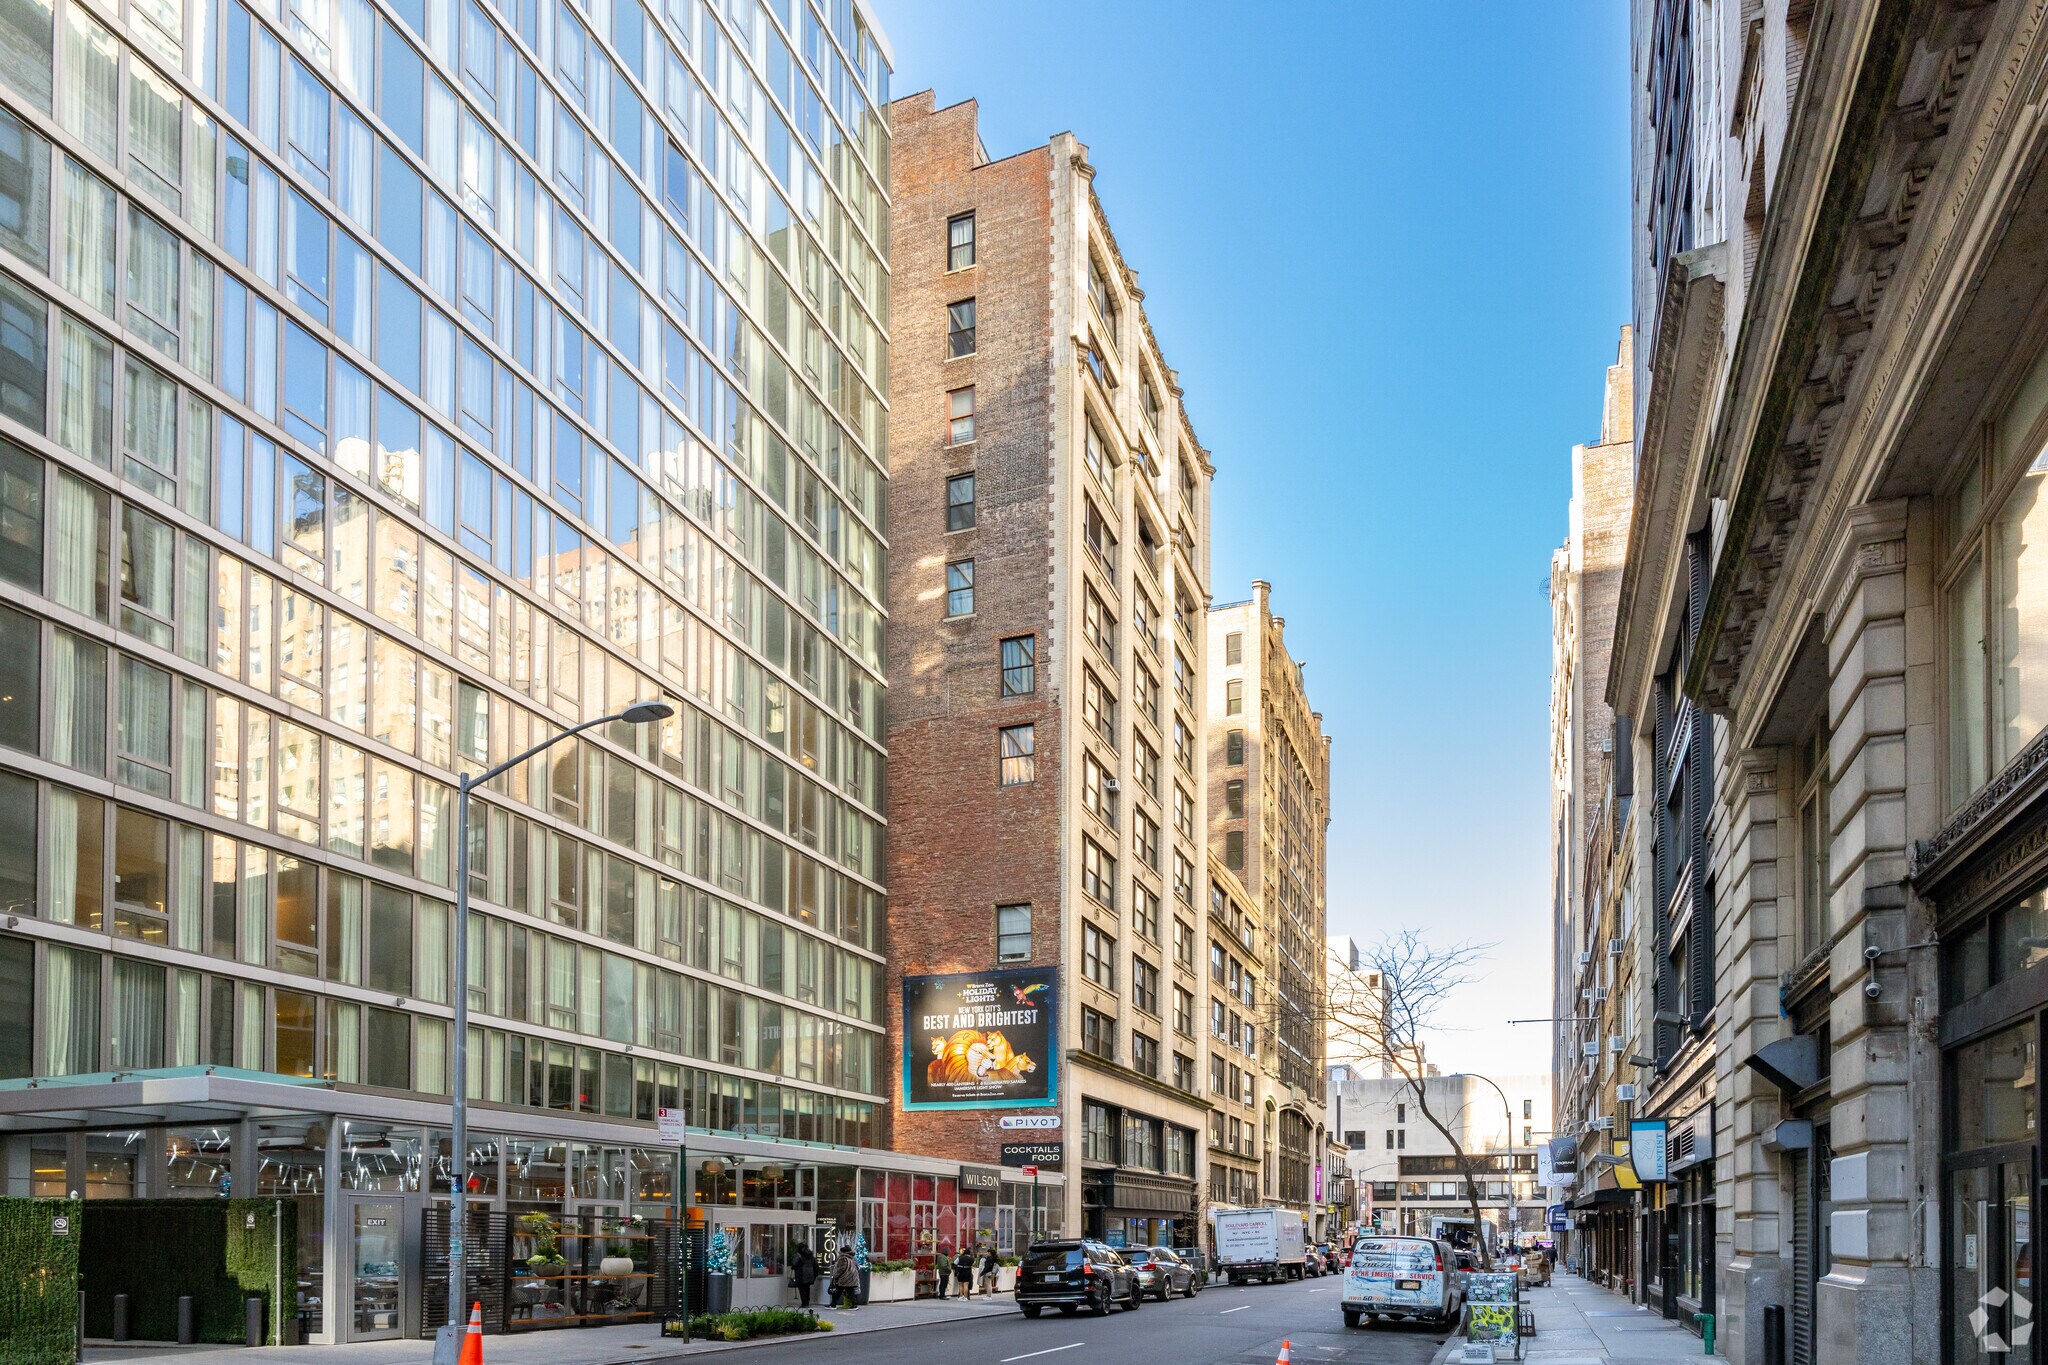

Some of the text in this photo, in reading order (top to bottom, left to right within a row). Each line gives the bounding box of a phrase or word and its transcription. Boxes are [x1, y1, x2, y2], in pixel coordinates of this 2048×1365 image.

[963, 987, 997, 996] HOLIDAY
[966, 994, 995, 1003] LIGHTS
[958, 1004, 1001, 1014] NEW YORK CITY'S
[924, 1009, 1038, 1030] BEST AND BRIGHTEST
[1016, 1118, 1056, 1126] PIVOT
[966, 1173, 999, 1186] WILSON
